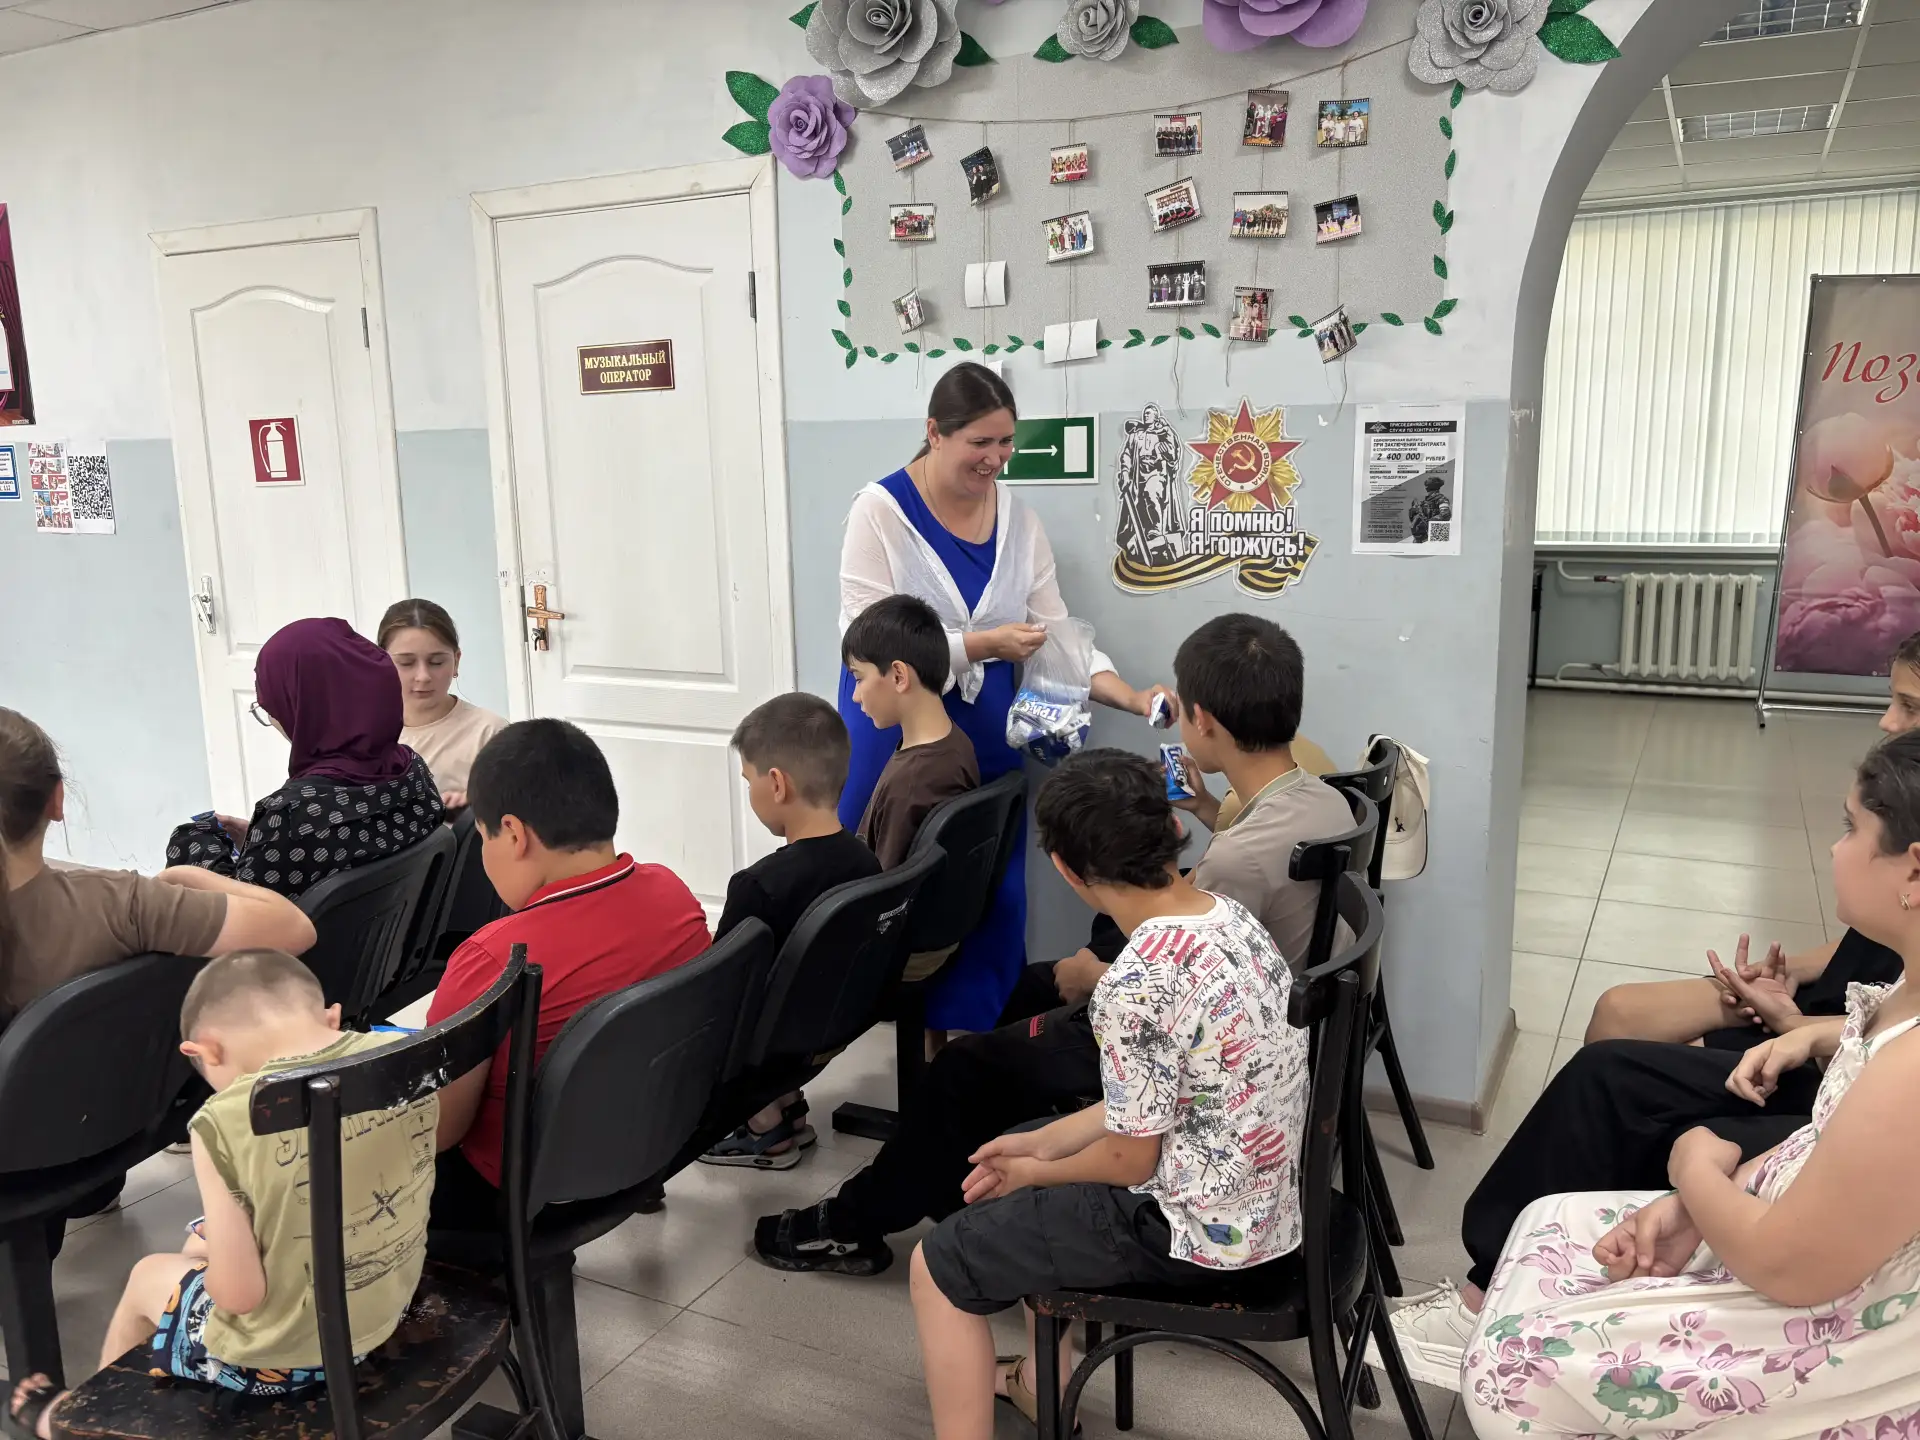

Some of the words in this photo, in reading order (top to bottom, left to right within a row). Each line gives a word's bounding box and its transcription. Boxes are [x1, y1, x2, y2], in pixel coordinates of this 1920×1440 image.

[584, 350, 666, 369] МУЗЫКАЛЬНЫЙ
[1821, 341, 1920, 403] Поз
[600, 369, 652, 384] ОПЕРАТОР
[1215, 434, 1266, 487] ОТЕЧЕСТВЕННАЯ
[1251, 452, 1270, 486] ВОЙНА
[1386, 452, 1401, 461] 400
[1405, 452, 1421, 461] 000
[1190, 508, 1205, 532] Я
[1210, 507, 1294, 533] помню!
[1190, 533, 1205, 556] Я
[1210, 532, 1305, 559] горжусь!
